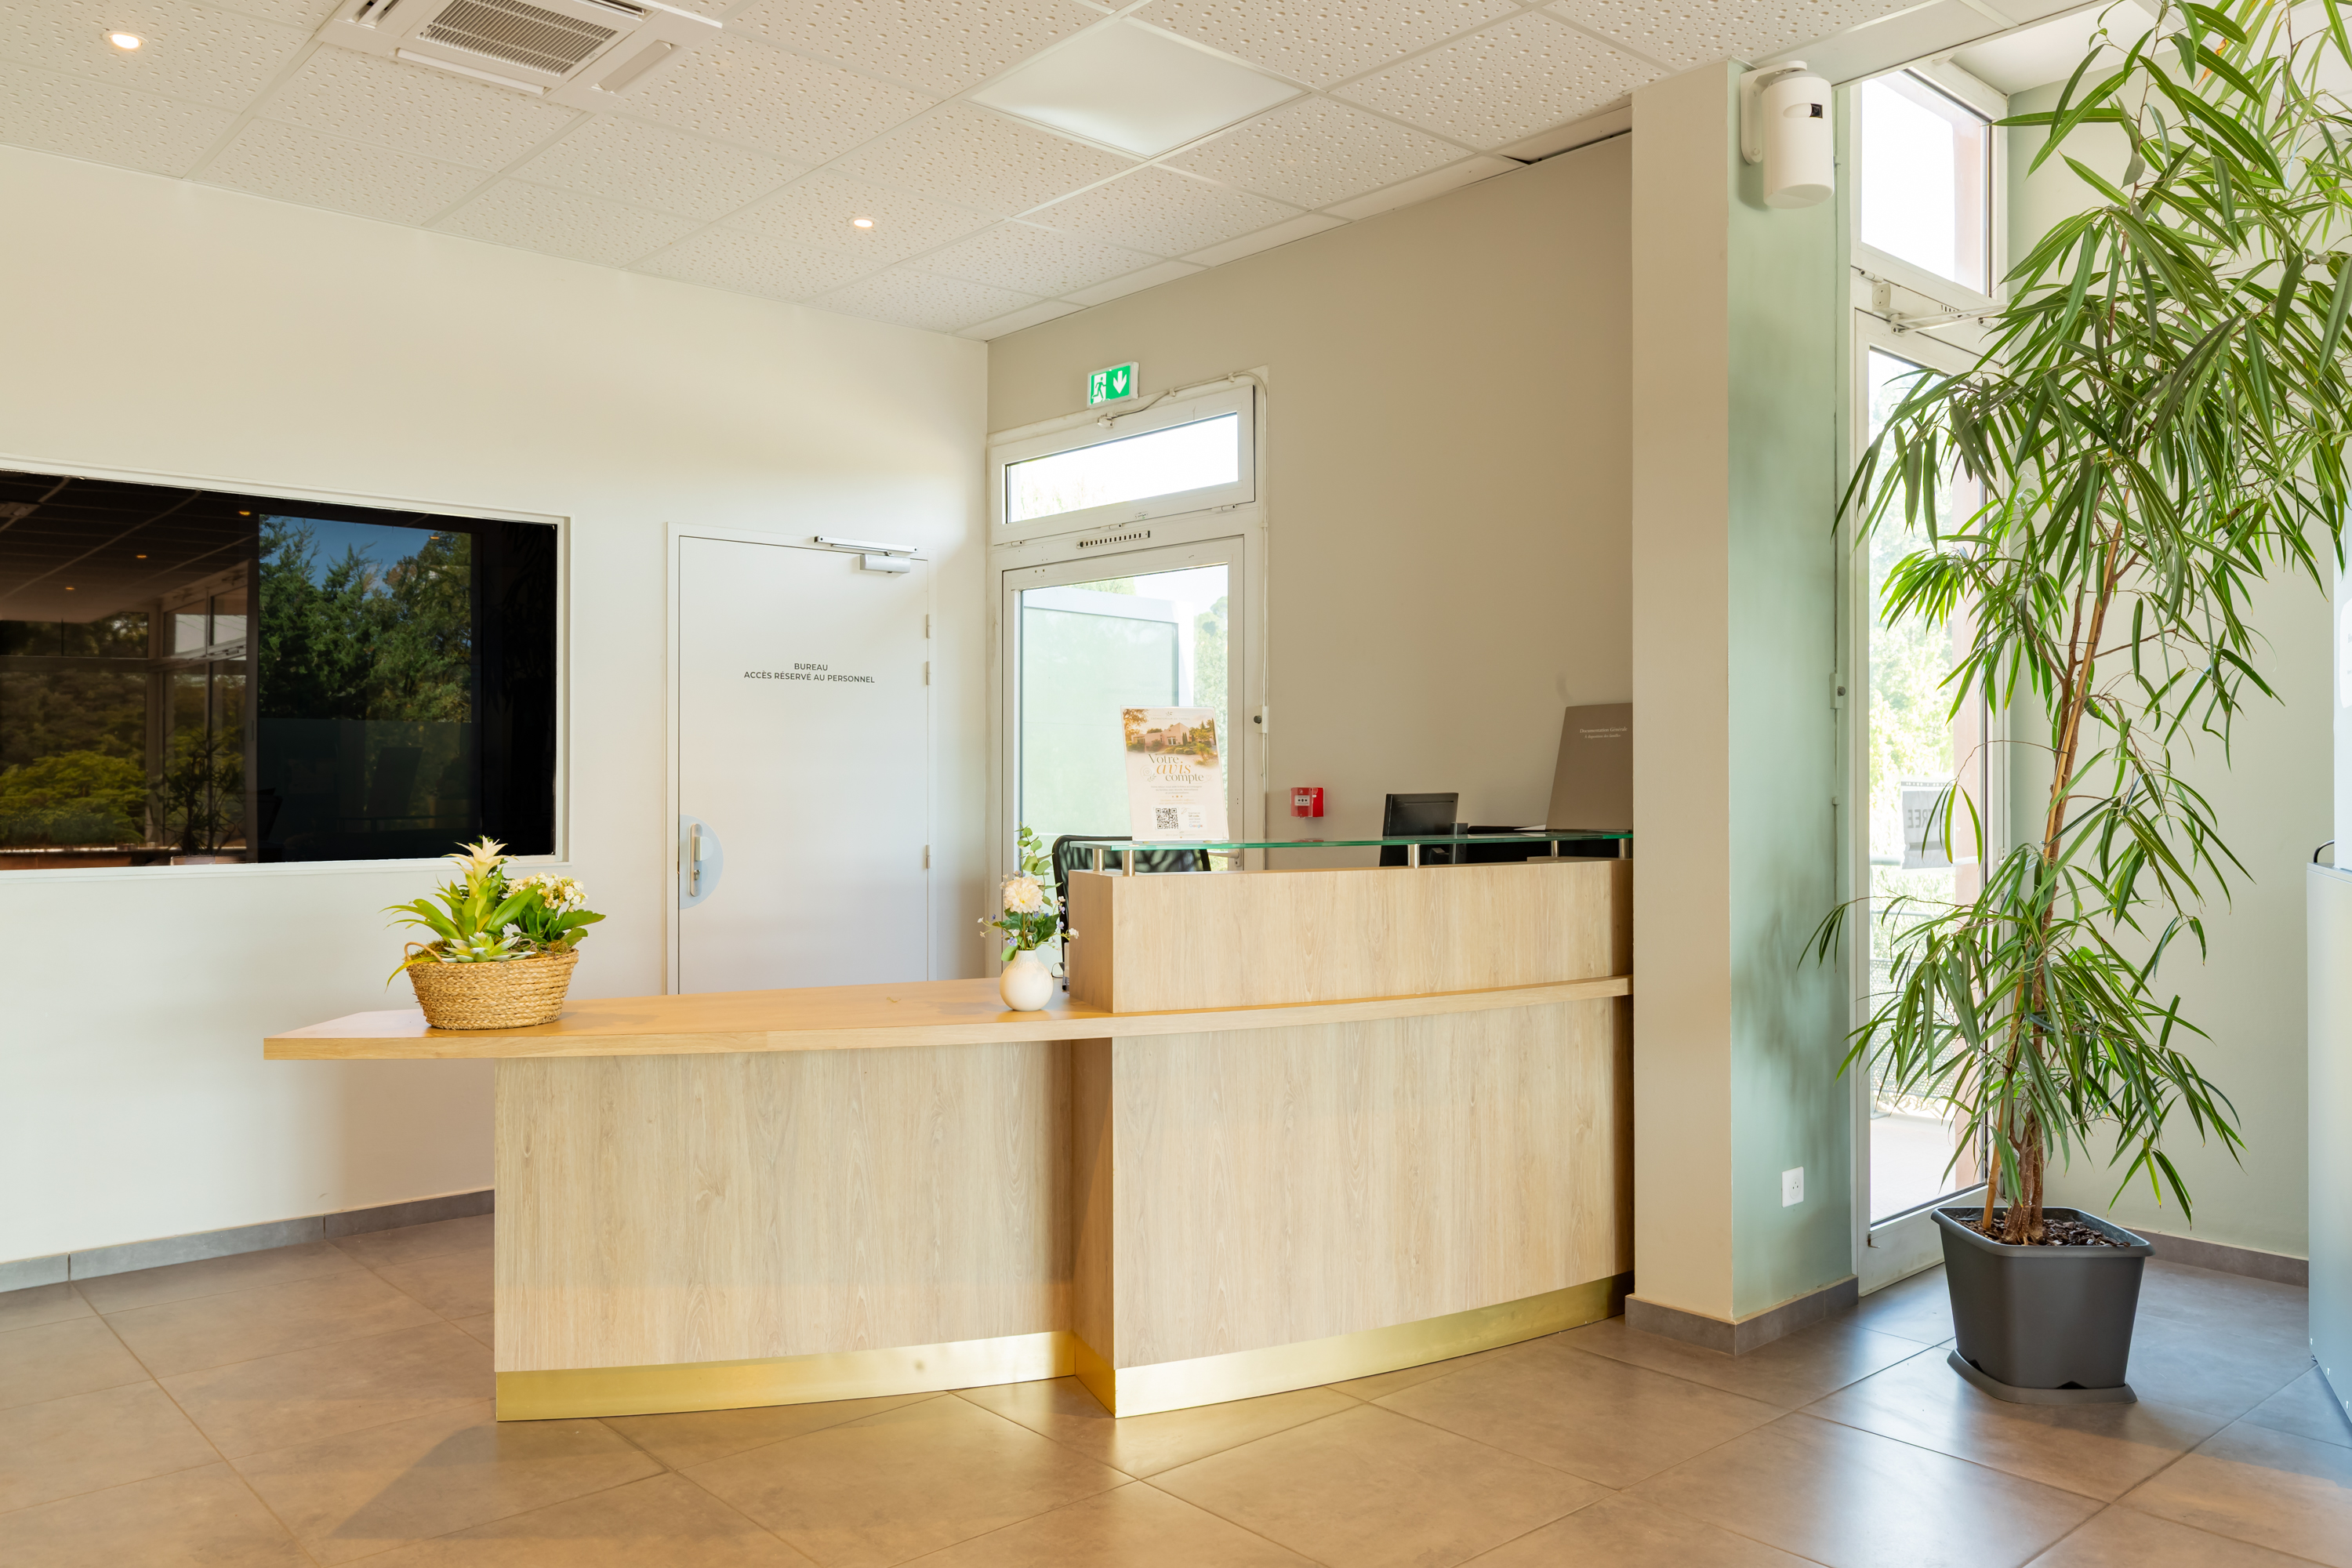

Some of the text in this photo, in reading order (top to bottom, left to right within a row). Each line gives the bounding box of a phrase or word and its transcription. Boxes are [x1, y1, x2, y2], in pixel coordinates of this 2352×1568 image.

[794, 662, 828, 671] BUREAU
[744, 670, 772, 679] ACCÈS
[774, 671, 811, 681] RÉSERVÉ
[827, 674, 875, 684] PERSONNEL
[1149, 753, 1179, 764] Votre
[1156, 761, 1191, 775] avis
[1165, 774, 1204, 784] compte
